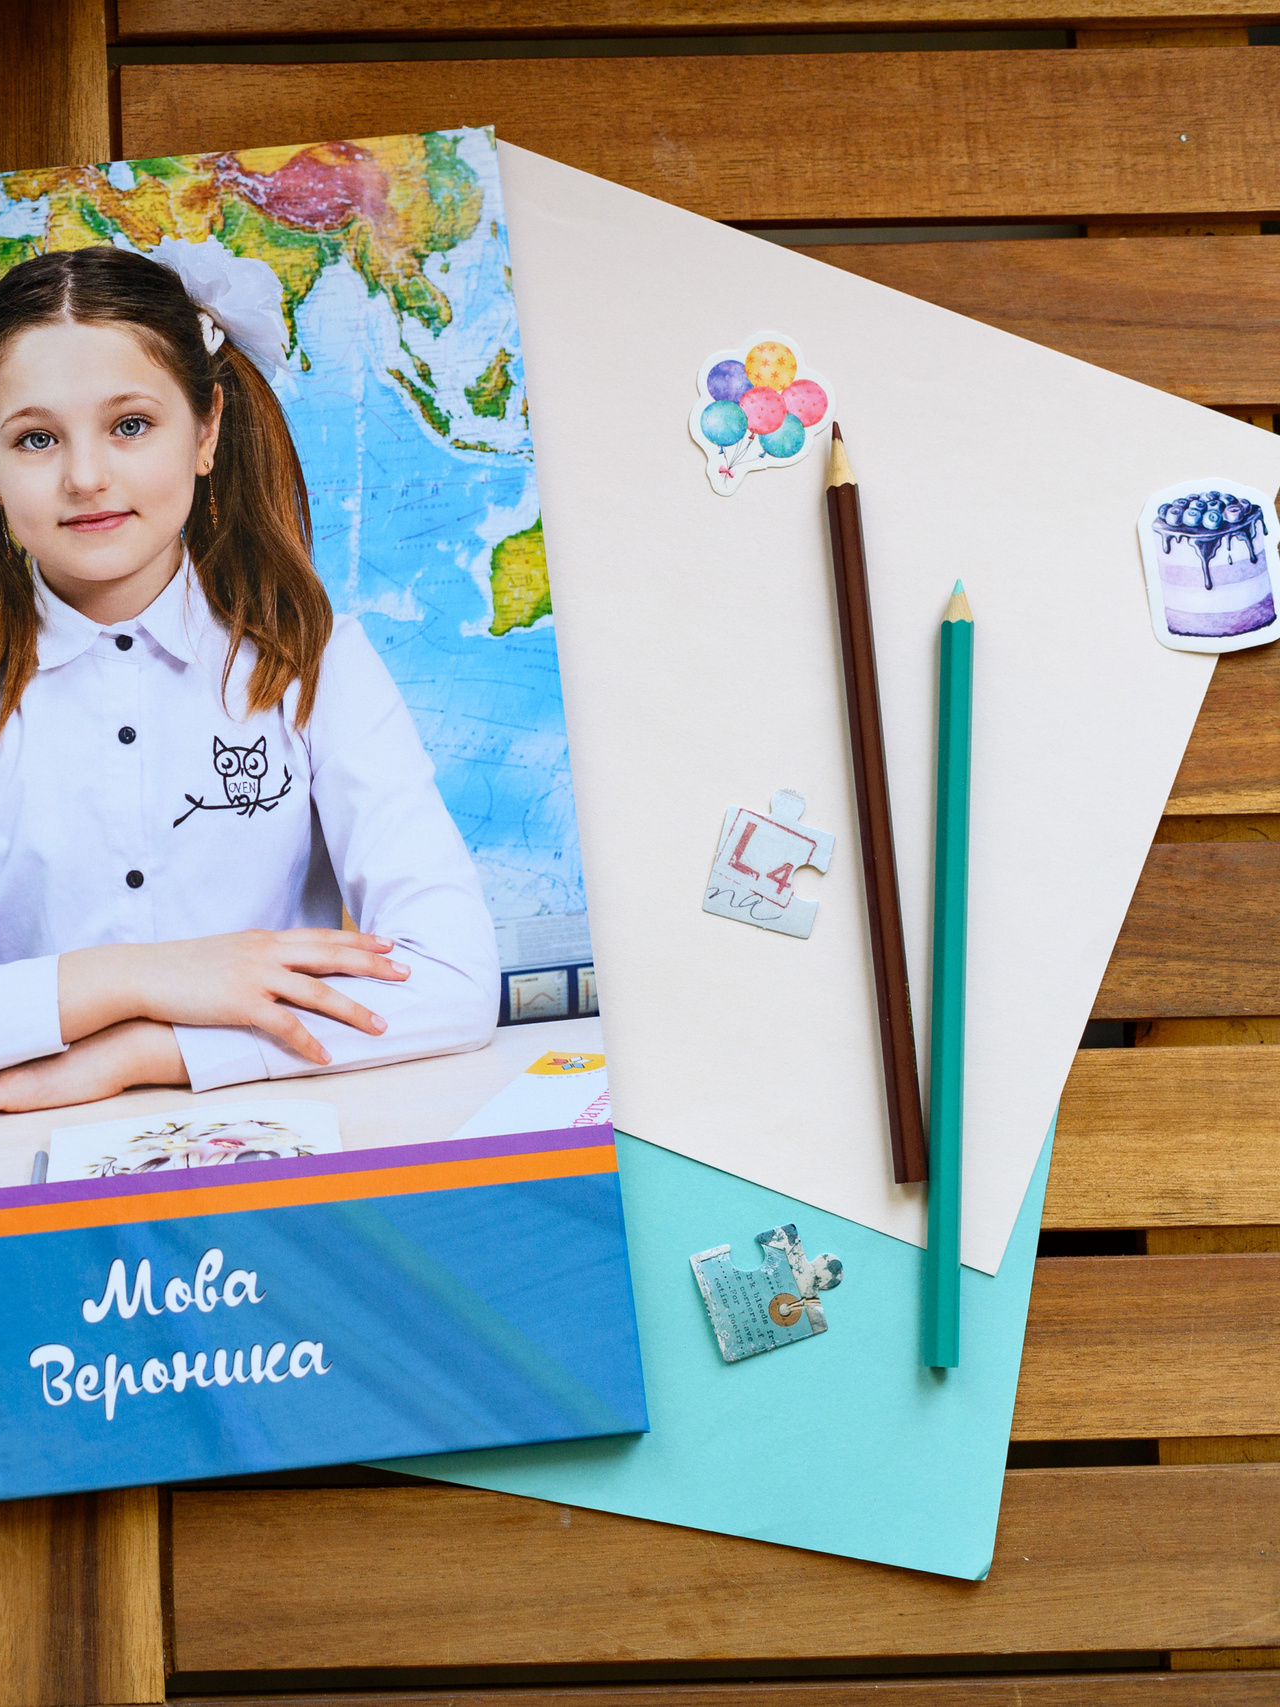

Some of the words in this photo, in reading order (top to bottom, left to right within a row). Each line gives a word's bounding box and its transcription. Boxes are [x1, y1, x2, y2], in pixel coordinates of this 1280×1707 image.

[228, 781, 257, 794] OVEN
[81, 1246, 267, 1324] Мова
[740, 1285, 758, 1324] corners
[753, 1290, 769, 1325] bleeds
[28, 1338, 334, 1422] Вероника
